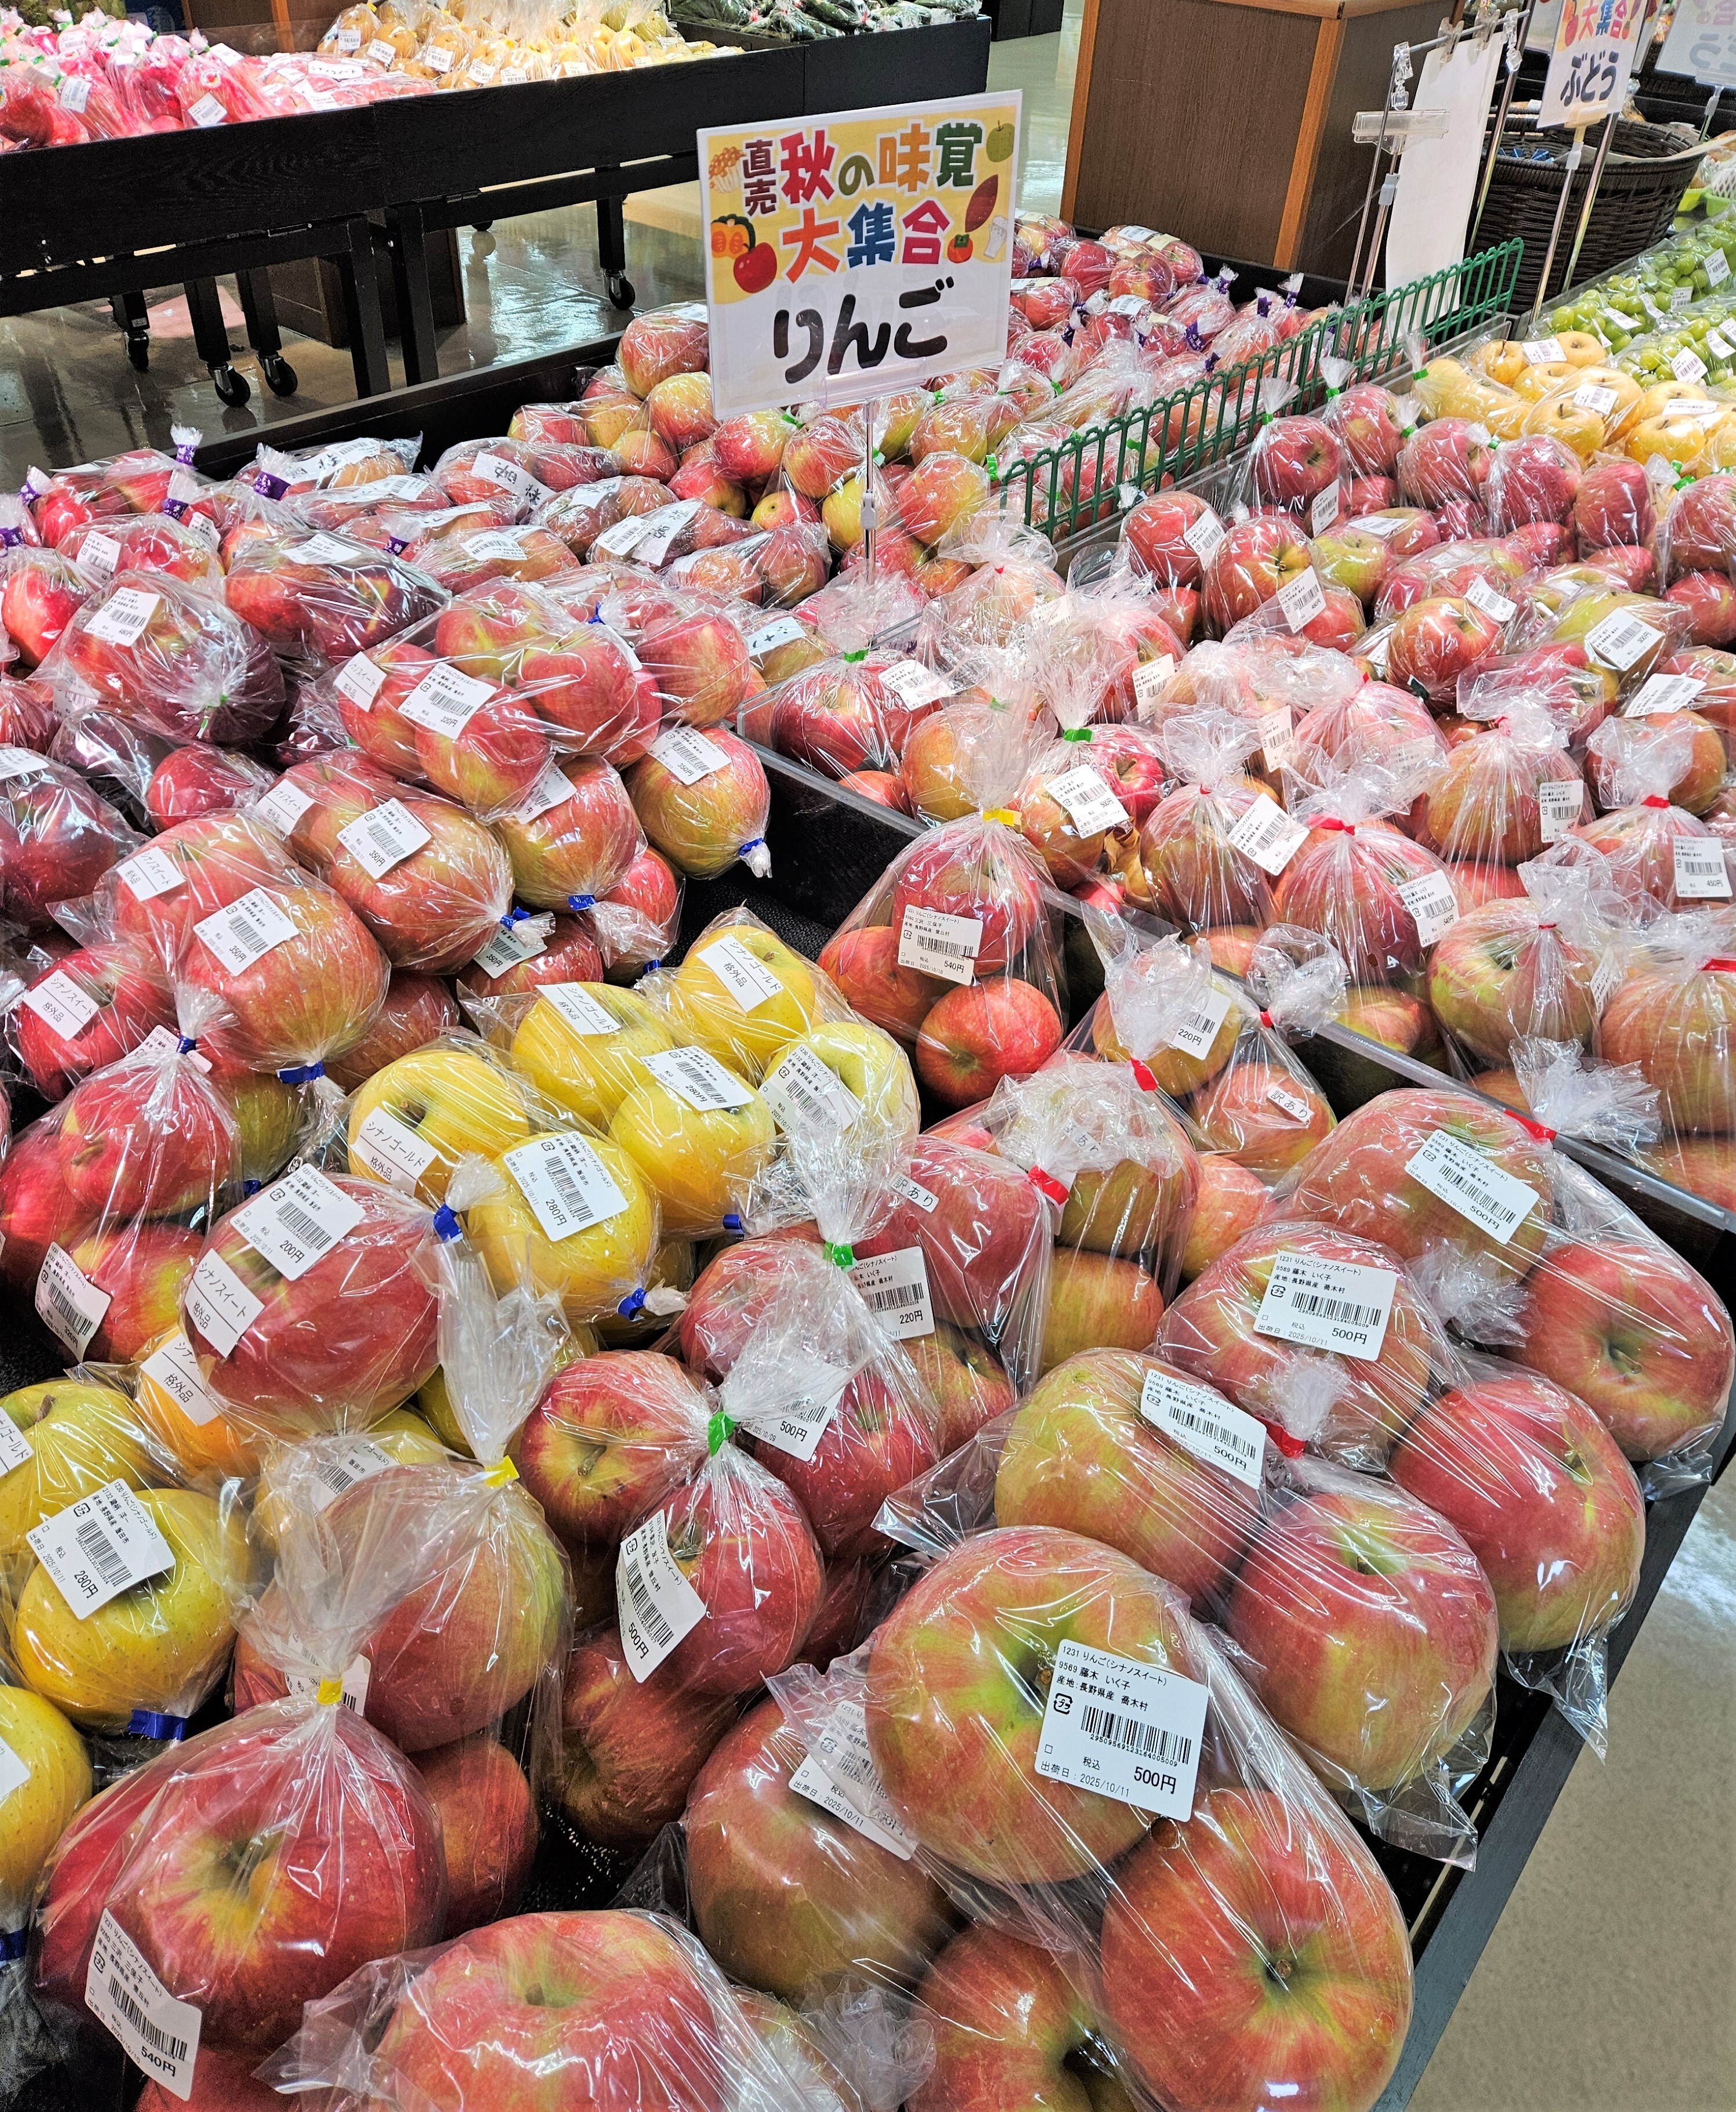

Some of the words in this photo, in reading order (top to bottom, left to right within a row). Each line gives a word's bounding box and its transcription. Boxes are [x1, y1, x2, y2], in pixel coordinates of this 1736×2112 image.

[1577, 0, 1629, 42] 大集合
[1560, 50, 1619, 107] ぶどう
[780, 122, 983, 205] 秋の味覚
[742, 139, 776, 217] 直売
[782, 200, 950, 283] 大集合
[774, 276, 954, 384] りんご
[440, 715, 458, 727] 320円
[677, 762, 694, 777] 350円
[141, 853, 172, 885] シナノスイート
[369, 850, 385, 867] 350円
[916, 909, 960, 924] りんご(シナノスイート)
[228, 945, 247, 963] 350円
[486, 954, 503, 967] 350円
[730, 942, 782, 991] シナノゴールド
[944, 960, 965, 974] 540円
[723, 961, 747, 988] 格外品
[51, 978, 92, 1015] シナノスイート
[567, 988, 614, 1031] シナノゴールド
[43, 1001, 64, 1023] 格外品
[1178, 1028, 1202, 1046] 220円
[685, 1084, 708, 1103] 280円
[1271, 1090, 1308, 1118] 訳あり
[366, 1121, 425, 1167] シナノゴールド
[370, 1156, 393, 1181] 格外品
[1450, 1141, 1508, 1182] りんご(シナノスイート)
[893, 1176, 933, 1207] 訳あり
[545, 1199, 567, 1226] 280円
[1469, 1205, 1500, 1230] 500円
[279, 1240, 305, 1263] 200円
[1294, 1258, 1362, 1276] りんご(シナノスイート)
[1312, 1272, 1332, 1281] いく子
[198, 1262, 246, 1319] シナノスイート
[193, 1299, 211, 1330] 格外品
[899, 1310, 924, 1324] 220円
[64, 1325, 79, 1349] 320円
[1332, 1327, 1367, 1345] 500円
[163, 1372, 194, 1403] 格外品
[1166, 1379, 1235, 1412] りんご(シナノスイート)
[780, 1421, 807, 1442] 500円
[1213, 1445, 1247, 1471] 500円
[102, 1488, 113, 1499] 3132
[114, 1481, 123, 1492] 1230
[121, 1491, 158, 1540] りんご(シナノゴールド)
[115, 1527, 130, 1544] 飯田市
[73, 1570, 99, 1599] 280円
[628, 1623, 649, 1659] 500円
[1059, 1661, 1078, 1673] 9569
[1079, 1667, 1099, 1680] 藤木
[1106, 1676, 1130, 1689] いく子
[1062, 1646, 1079, 1658] 1231
[1082, 1651, 1168, 1686] りんご(シナノスイート)
[1056, 1675, 1115, 1700] 産地:長野県産
[1121, 1695, 1148, 1712] 喬木村
[1090, 1734, 1177, 1767] 29509569123164005009
[1082, 1756, 1100, 1771] 税込
[1133, 1767, 1177, 1794] 500円
[114, 1929, 162, 1997] りんご(シナノスイート)
[140, 2045, 176, 2077] 540円
